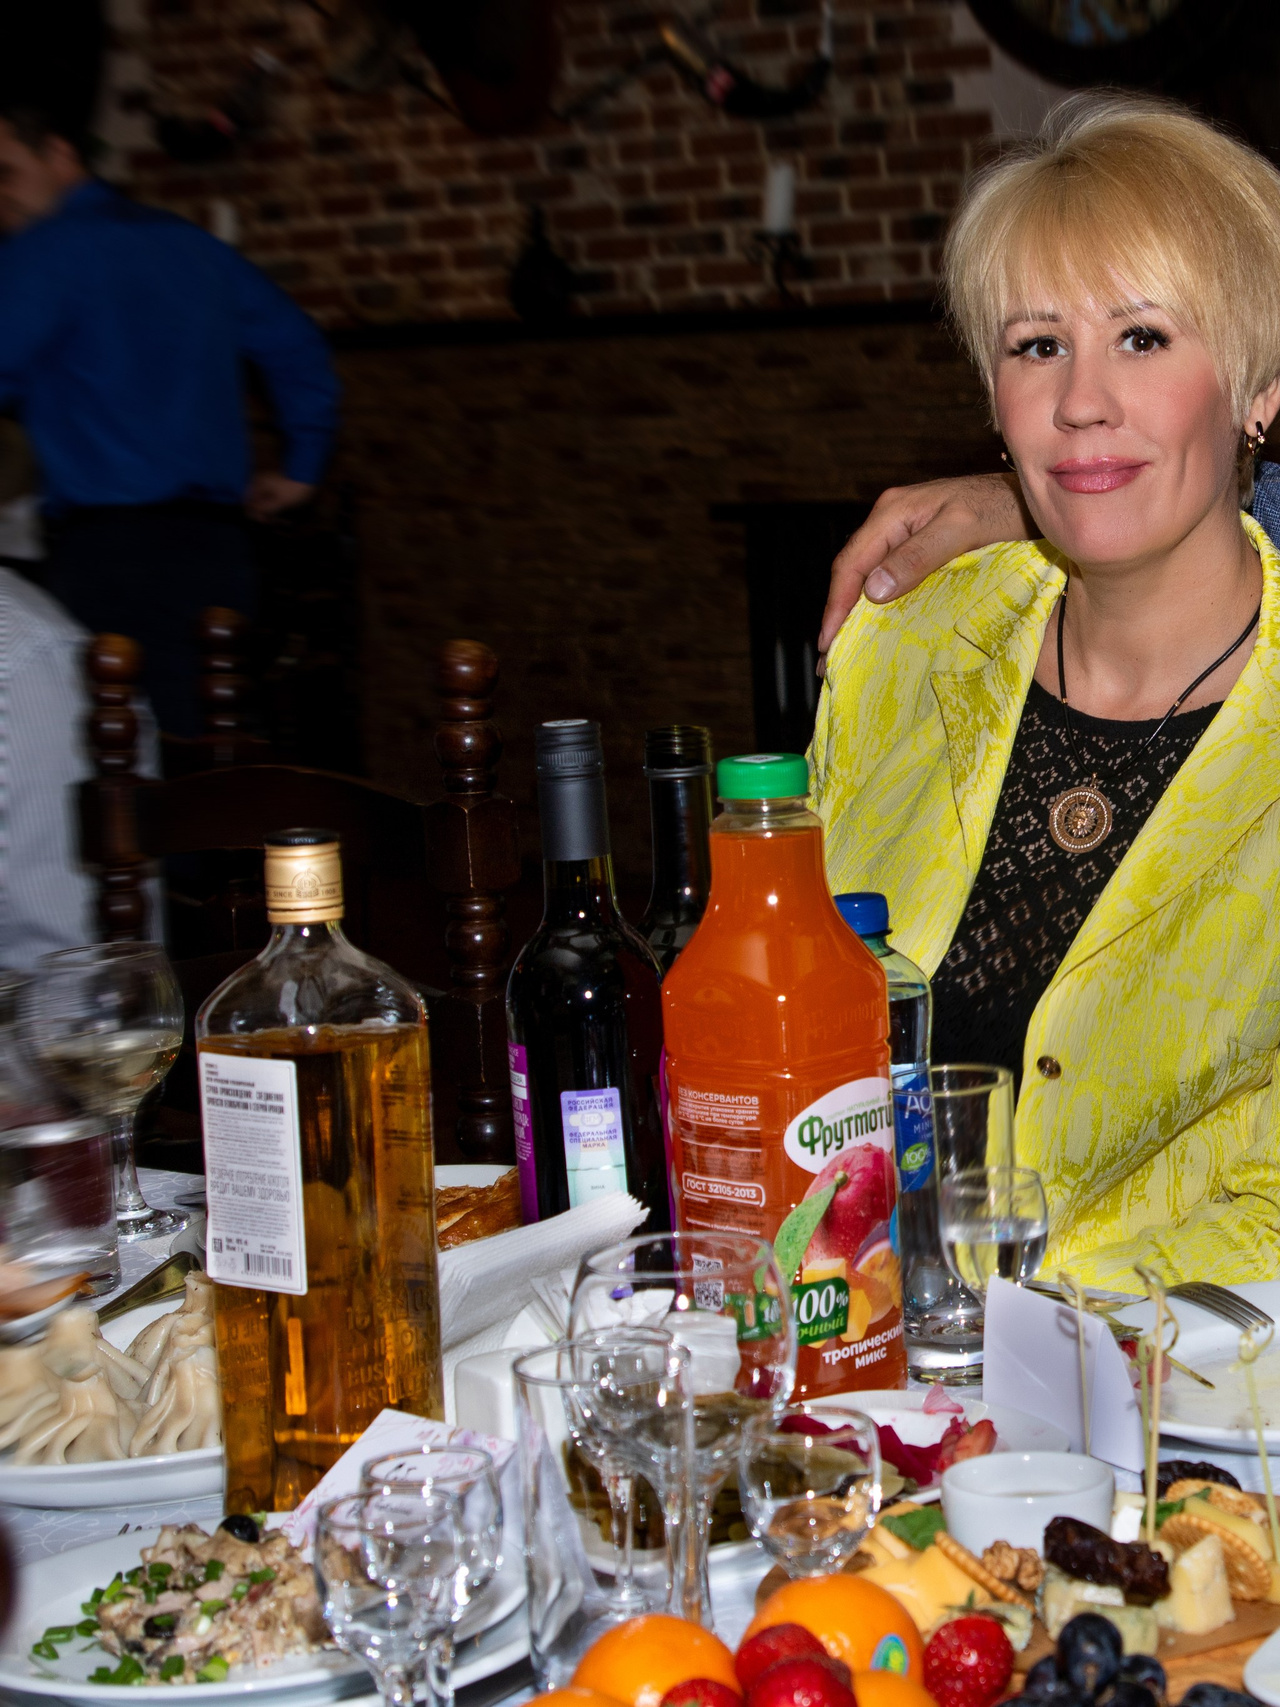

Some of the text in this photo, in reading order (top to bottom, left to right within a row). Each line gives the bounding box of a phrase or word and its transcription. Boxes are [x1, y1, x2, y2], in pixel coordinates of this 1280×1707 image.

[568, 1097, 613, 1105] РОССИЙСКАЯ
[688, 1090, 759, 1105] КОНСЕРВАНТОВ
[568, 1103, 613, 1111] ФЕДЕРАЦИЯ
[569, 1129, 617, 1137] ФЕДЕРАЛЬНАЯ
[569, 1135, 617, 1143] СПЕЦИАЛЬНАЯ
[686, 1178, 706, 1191] ГОСТ
[708, 1183, 756, 1199] 32105-2013
[797, 1312, 845, 1339] очный
[855, 1346, 887, 1369] микс
